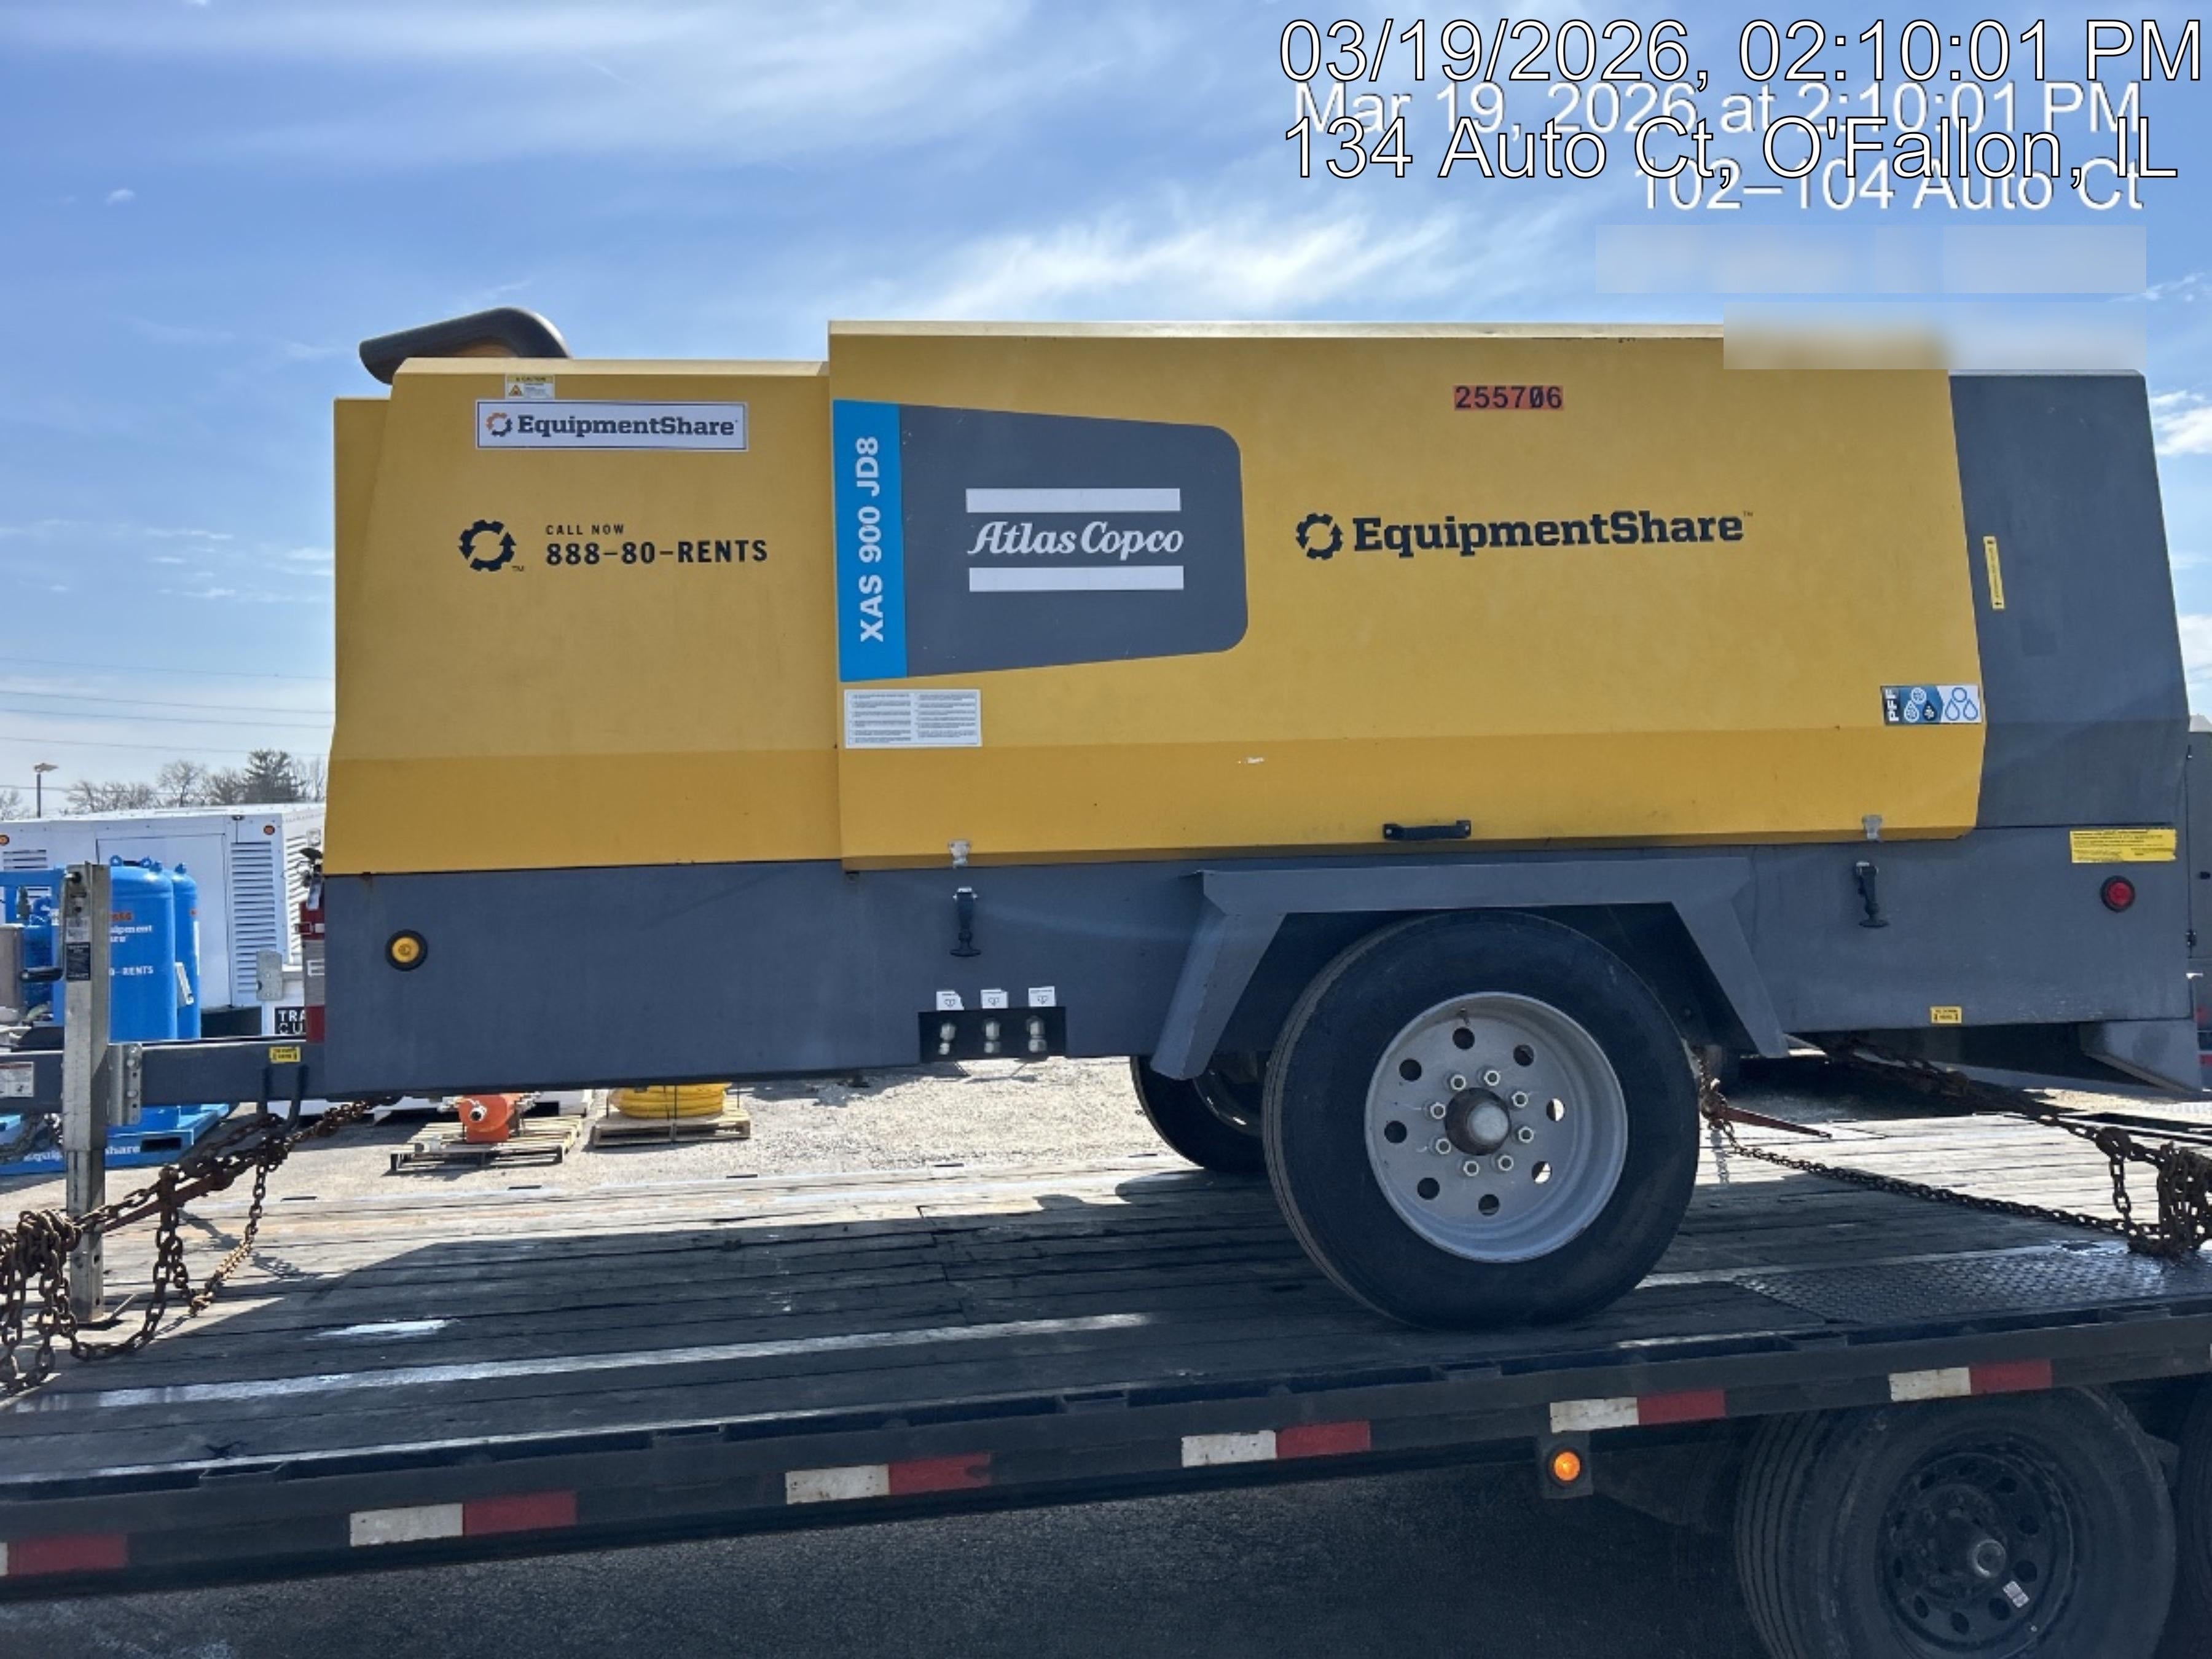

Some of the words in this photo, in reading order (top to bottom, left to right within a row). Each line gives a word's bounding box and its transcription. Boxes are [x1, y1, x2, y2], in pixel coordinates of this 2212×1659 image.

[1455, 385, 1563, 409] 255706
[517, 415, 735, 437] EquipmentShare
[855, 436, 879, 496] JD8
[546, 525, 584, 536] CALL
[591, 524, 625, 535] NOW
[857, 506, 882, 562] 900
[968, 522, 1076, 555] Atlas
[1081, 522, 1184, 560] Copco
[1353, 511, 1744, 558] EquipmentShare
[860, 575, 884, 643] XAS
[1885, 688, 1899, 722] PFF
